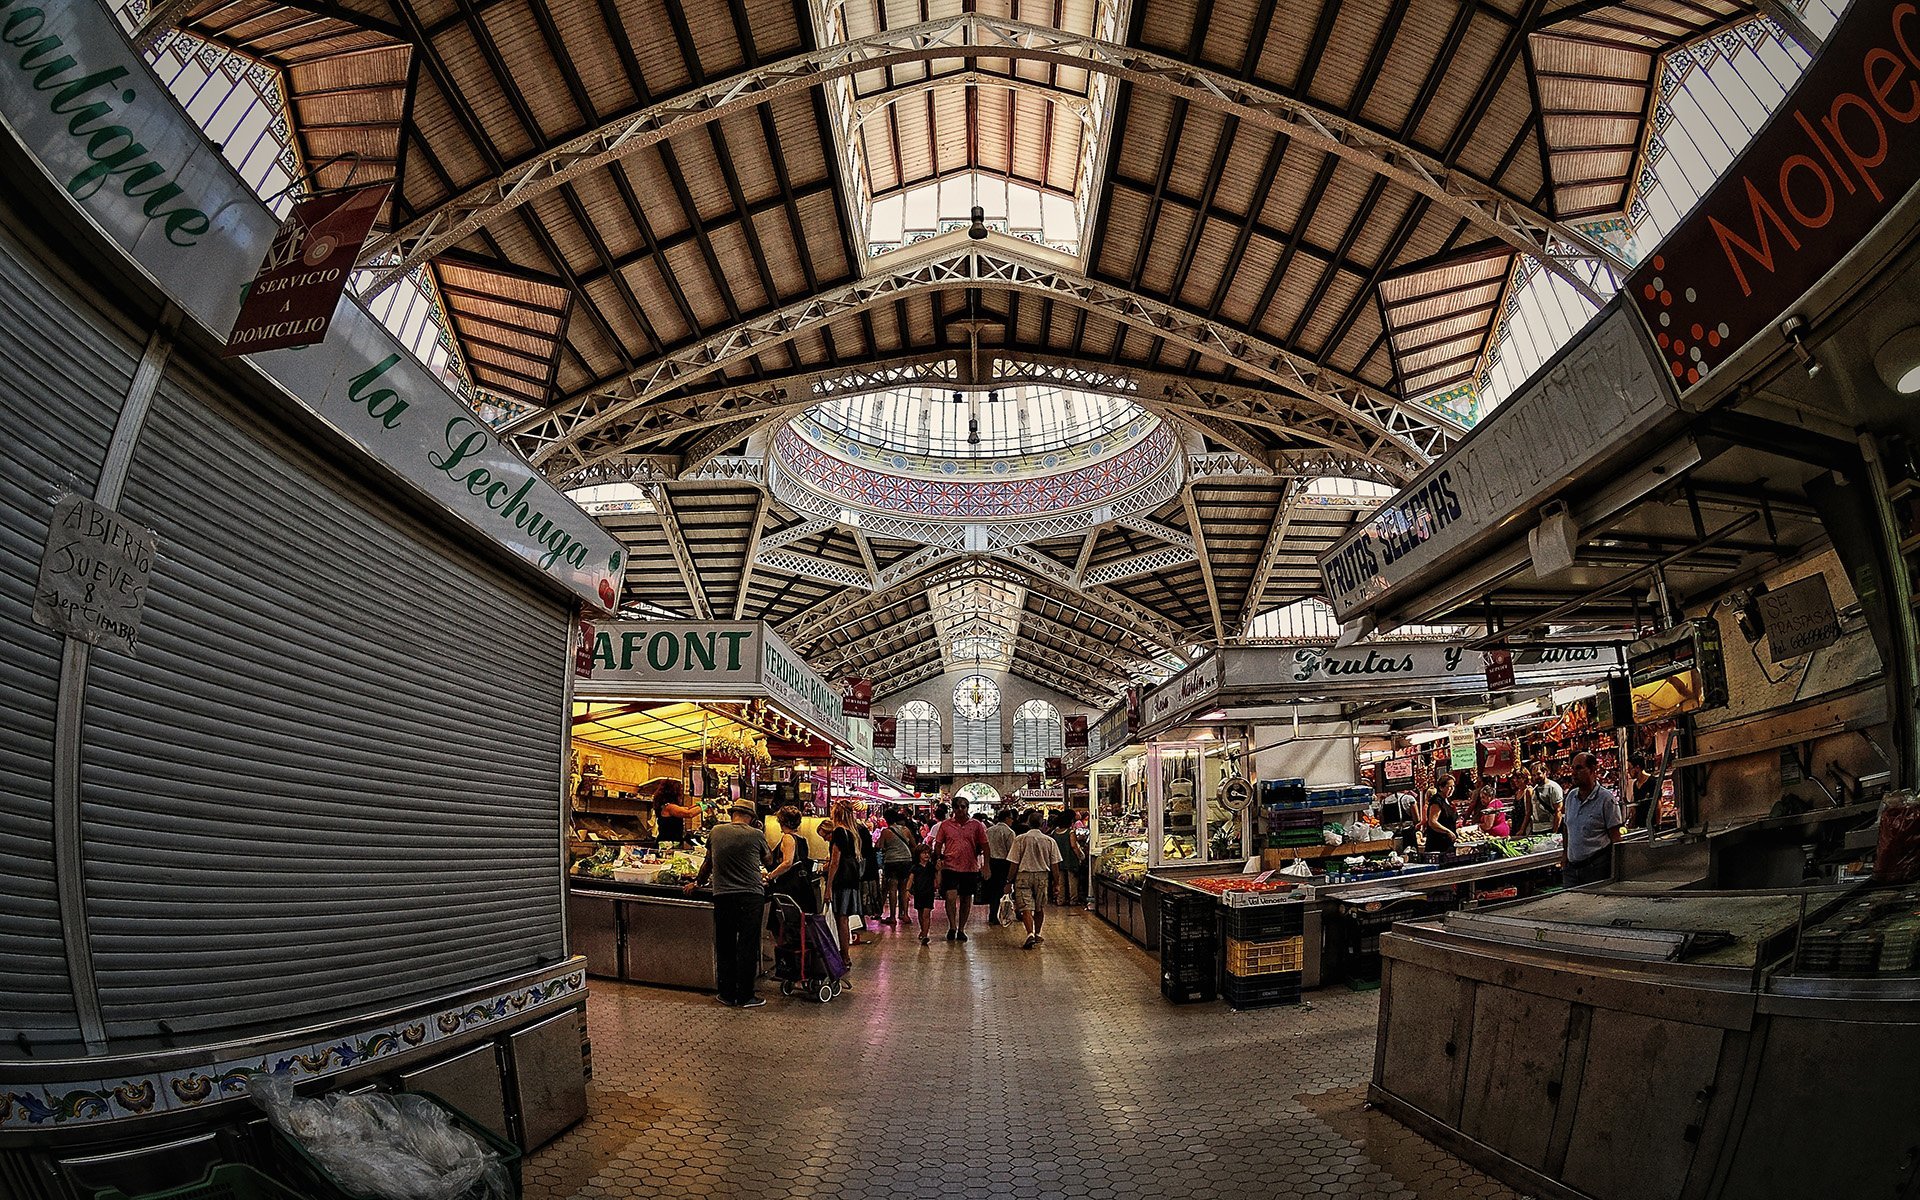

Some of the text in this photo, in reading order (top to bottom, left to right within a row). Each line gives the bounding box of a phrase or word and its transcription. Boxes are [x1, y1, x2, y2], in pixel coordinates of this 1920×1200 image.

[0, 0, 589, 570] outique la Lechuga
[256, 267, 340, 295] SERVICIO
[280, 299, 291, 313] A
[232, 316, 326, 345] DOMICILIO
[62, 500, 149, 574] ABIERTO
[1324, 533, 1379, 601] FRUTAS
[1377, 469, 1462, 566] SELECTAS
[50, 540, 143, 609] JUEVES
[84, 582, 96, 604] 8
[1766, 592, 1793, 619] SE
[1767, 609, 1833, 637] TRASPASA
[765, 640, 809, 700] VERDURAS
[1293, 648, 1414, 681] Frutas
[1261, 896, 1287, 905] Venosta
